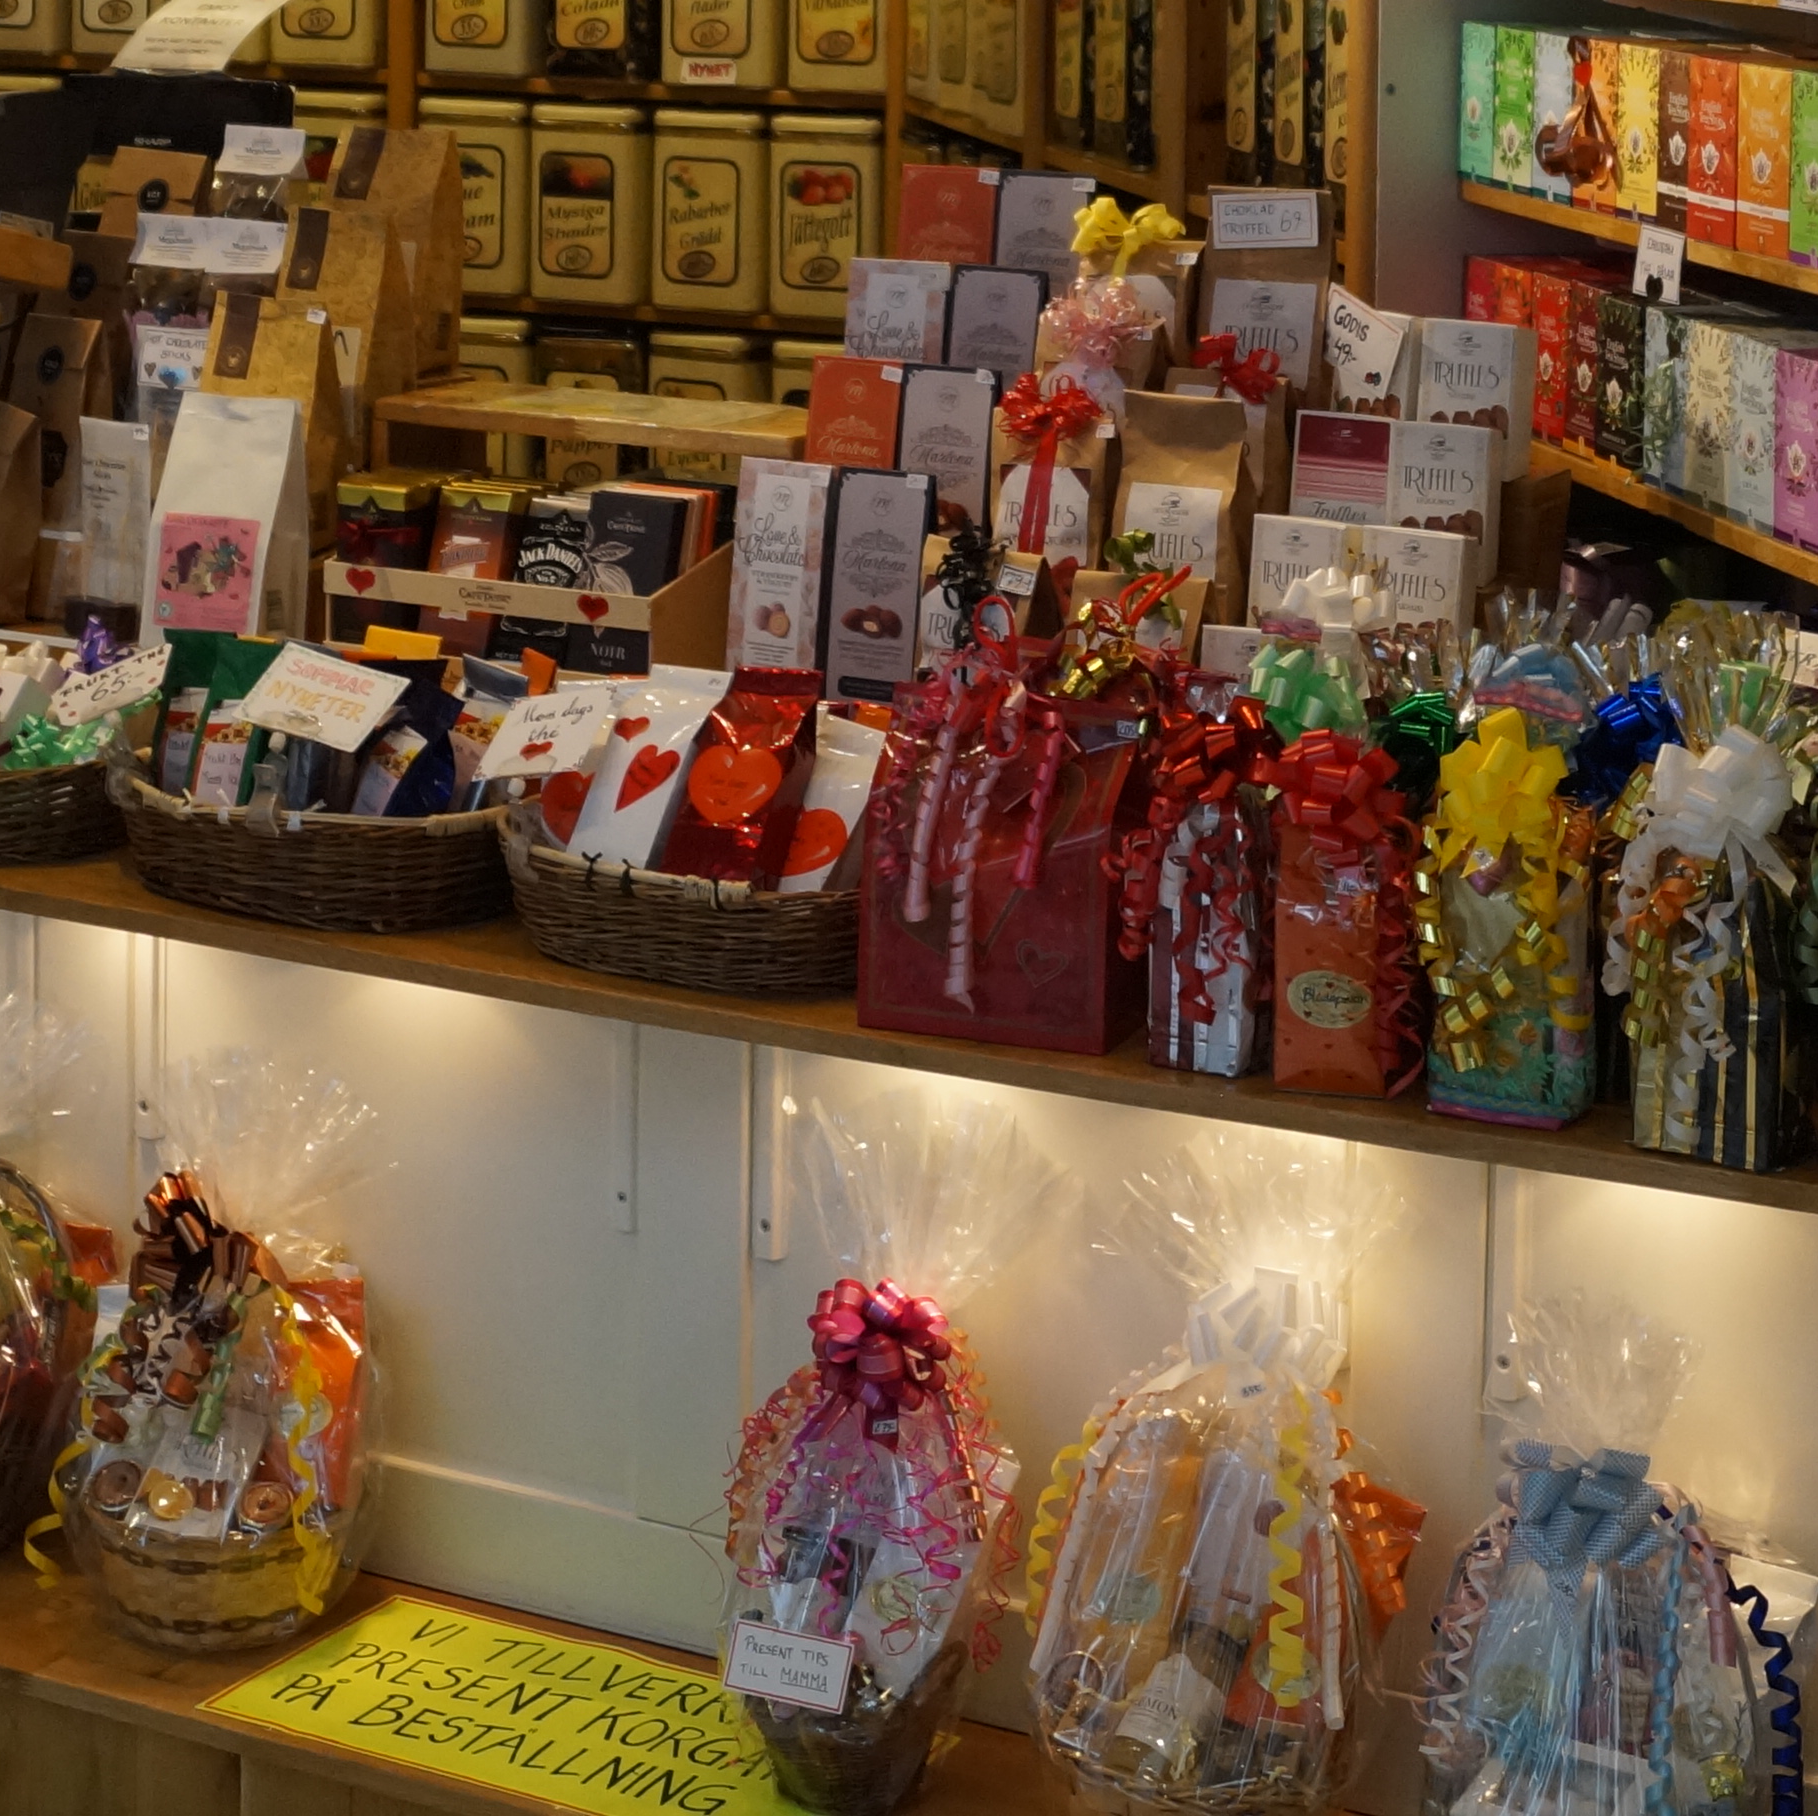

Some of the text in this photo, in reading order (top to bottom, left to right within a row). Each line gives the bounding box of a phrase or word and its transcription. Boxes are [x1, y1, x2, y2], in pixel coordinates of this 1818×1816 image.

[546, 204, 606, 223] Mysiga
[1333, 303, 1370, 343] GODIS
[1431, 361, 1500, 387] TRUFFLES
[1400, 470, 1476, 494] TRUFFLES
[516, 541, 548, 569] JACK
[589, 642, 627, 661] NOIR
[287, 657, 376, 697] SOMMAR
[264, 680, 369, 724] NYHETER
[560, 695, 595, 732] dags
[411, 1617, 469, 1647] VI
[744, 1636, 830, 1666] PRESENT TIPS
[330, 1641, 591, 1722] PRESENT
[740, 1662, 828, 1690] TILL MAMMA
[272, 1672, 740, 1815] PÅ BESTÄLLNING
